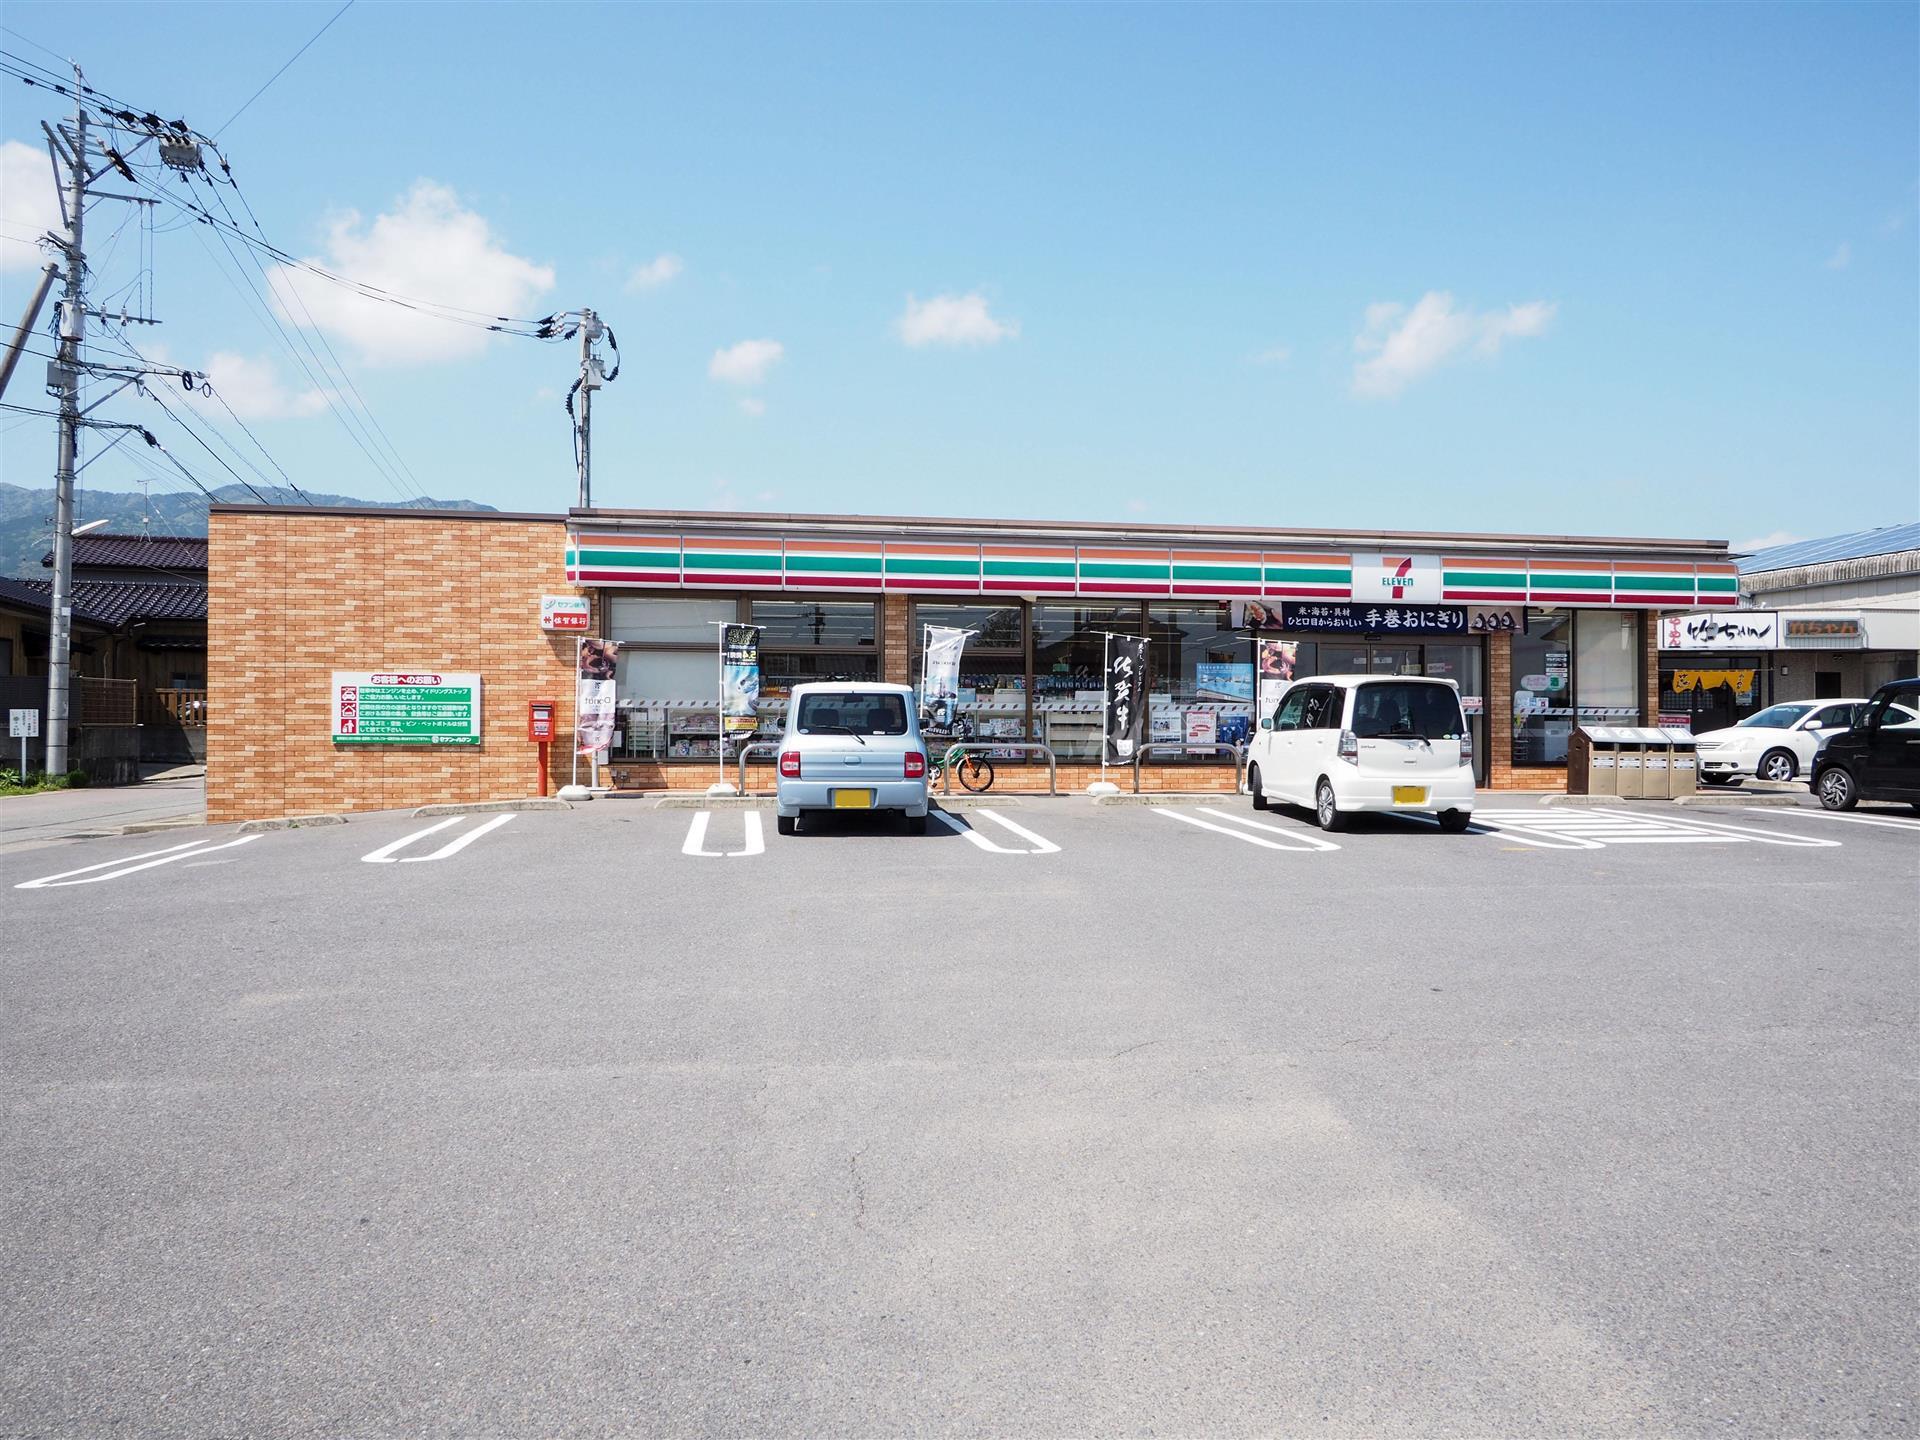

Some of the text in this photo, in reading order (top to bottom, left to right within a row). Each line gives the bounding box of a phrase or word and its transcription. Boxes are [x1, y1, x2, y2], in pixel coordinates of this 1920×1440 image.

[1297, 606, 1351, 617] 米・海苔・具材
[554, 616, 586, 625] 佐賀銀行
[1287, 616, 1362, 627] ひと口目からおいしい
[1364, 608, 1464, 629] 手巻おにぎり
[372, 675, 441, 685] お客様へのお願い
[1113, 656, 1134, 731] 佐賀牛
